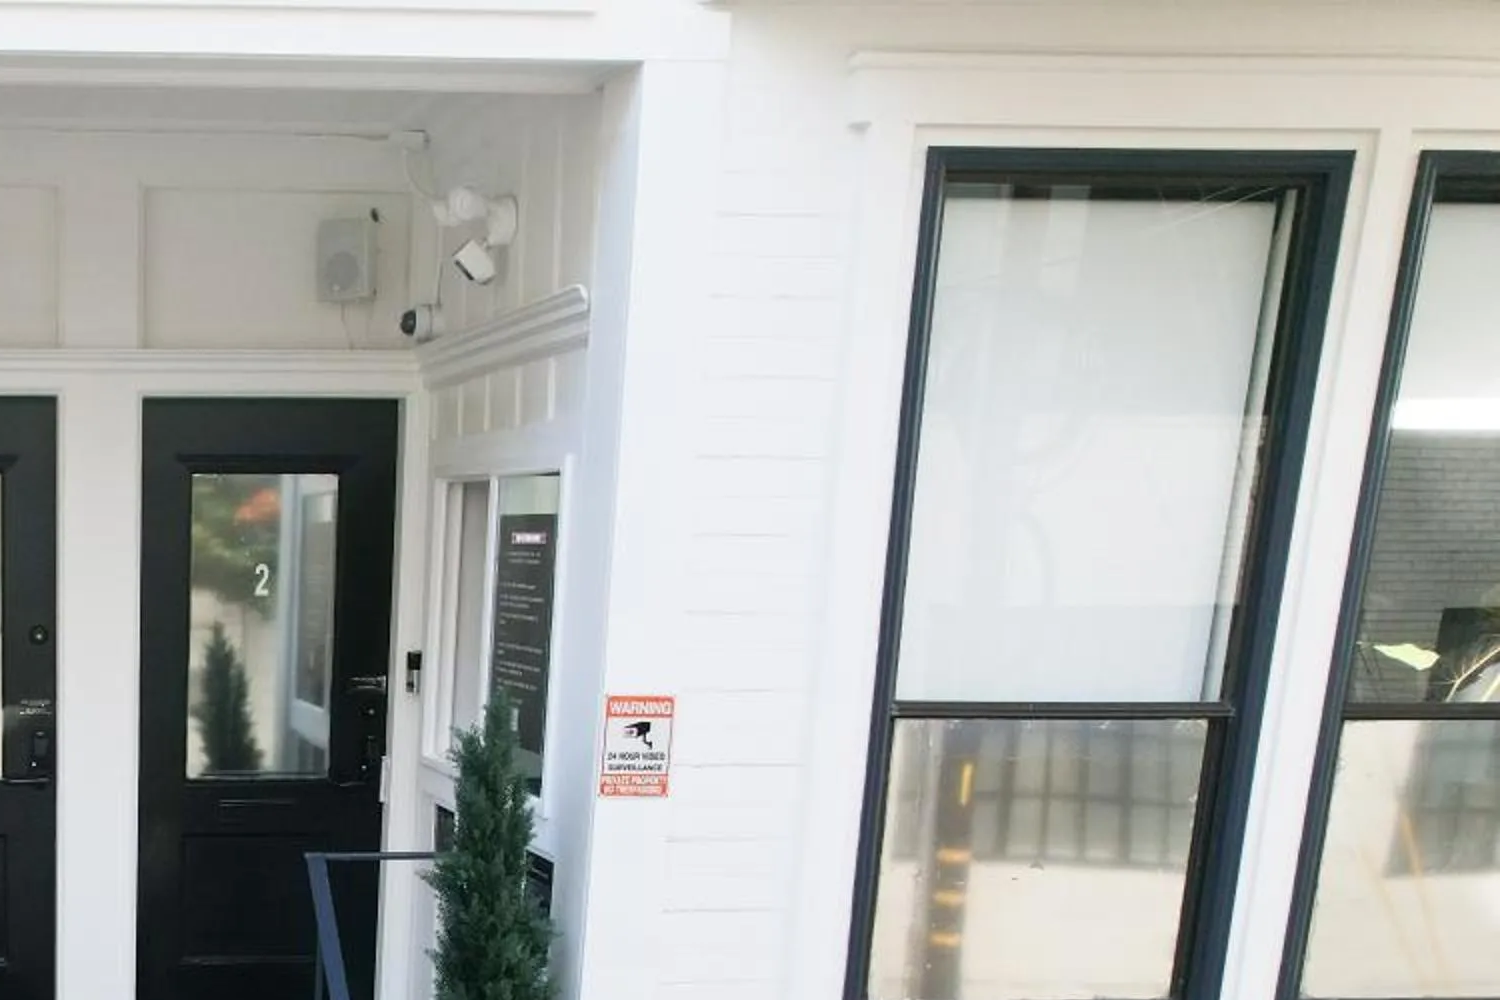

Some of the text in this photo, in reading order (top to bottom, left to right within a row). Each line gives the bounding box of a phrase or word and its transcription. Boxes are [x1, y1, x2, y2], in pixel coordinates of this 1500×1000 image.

[255, 563, 269, 595] 2
[610, 701, 672, 715] WARNING
[607, 752, 616, 760] 24
[619, 752, 640, 760] HOUR
